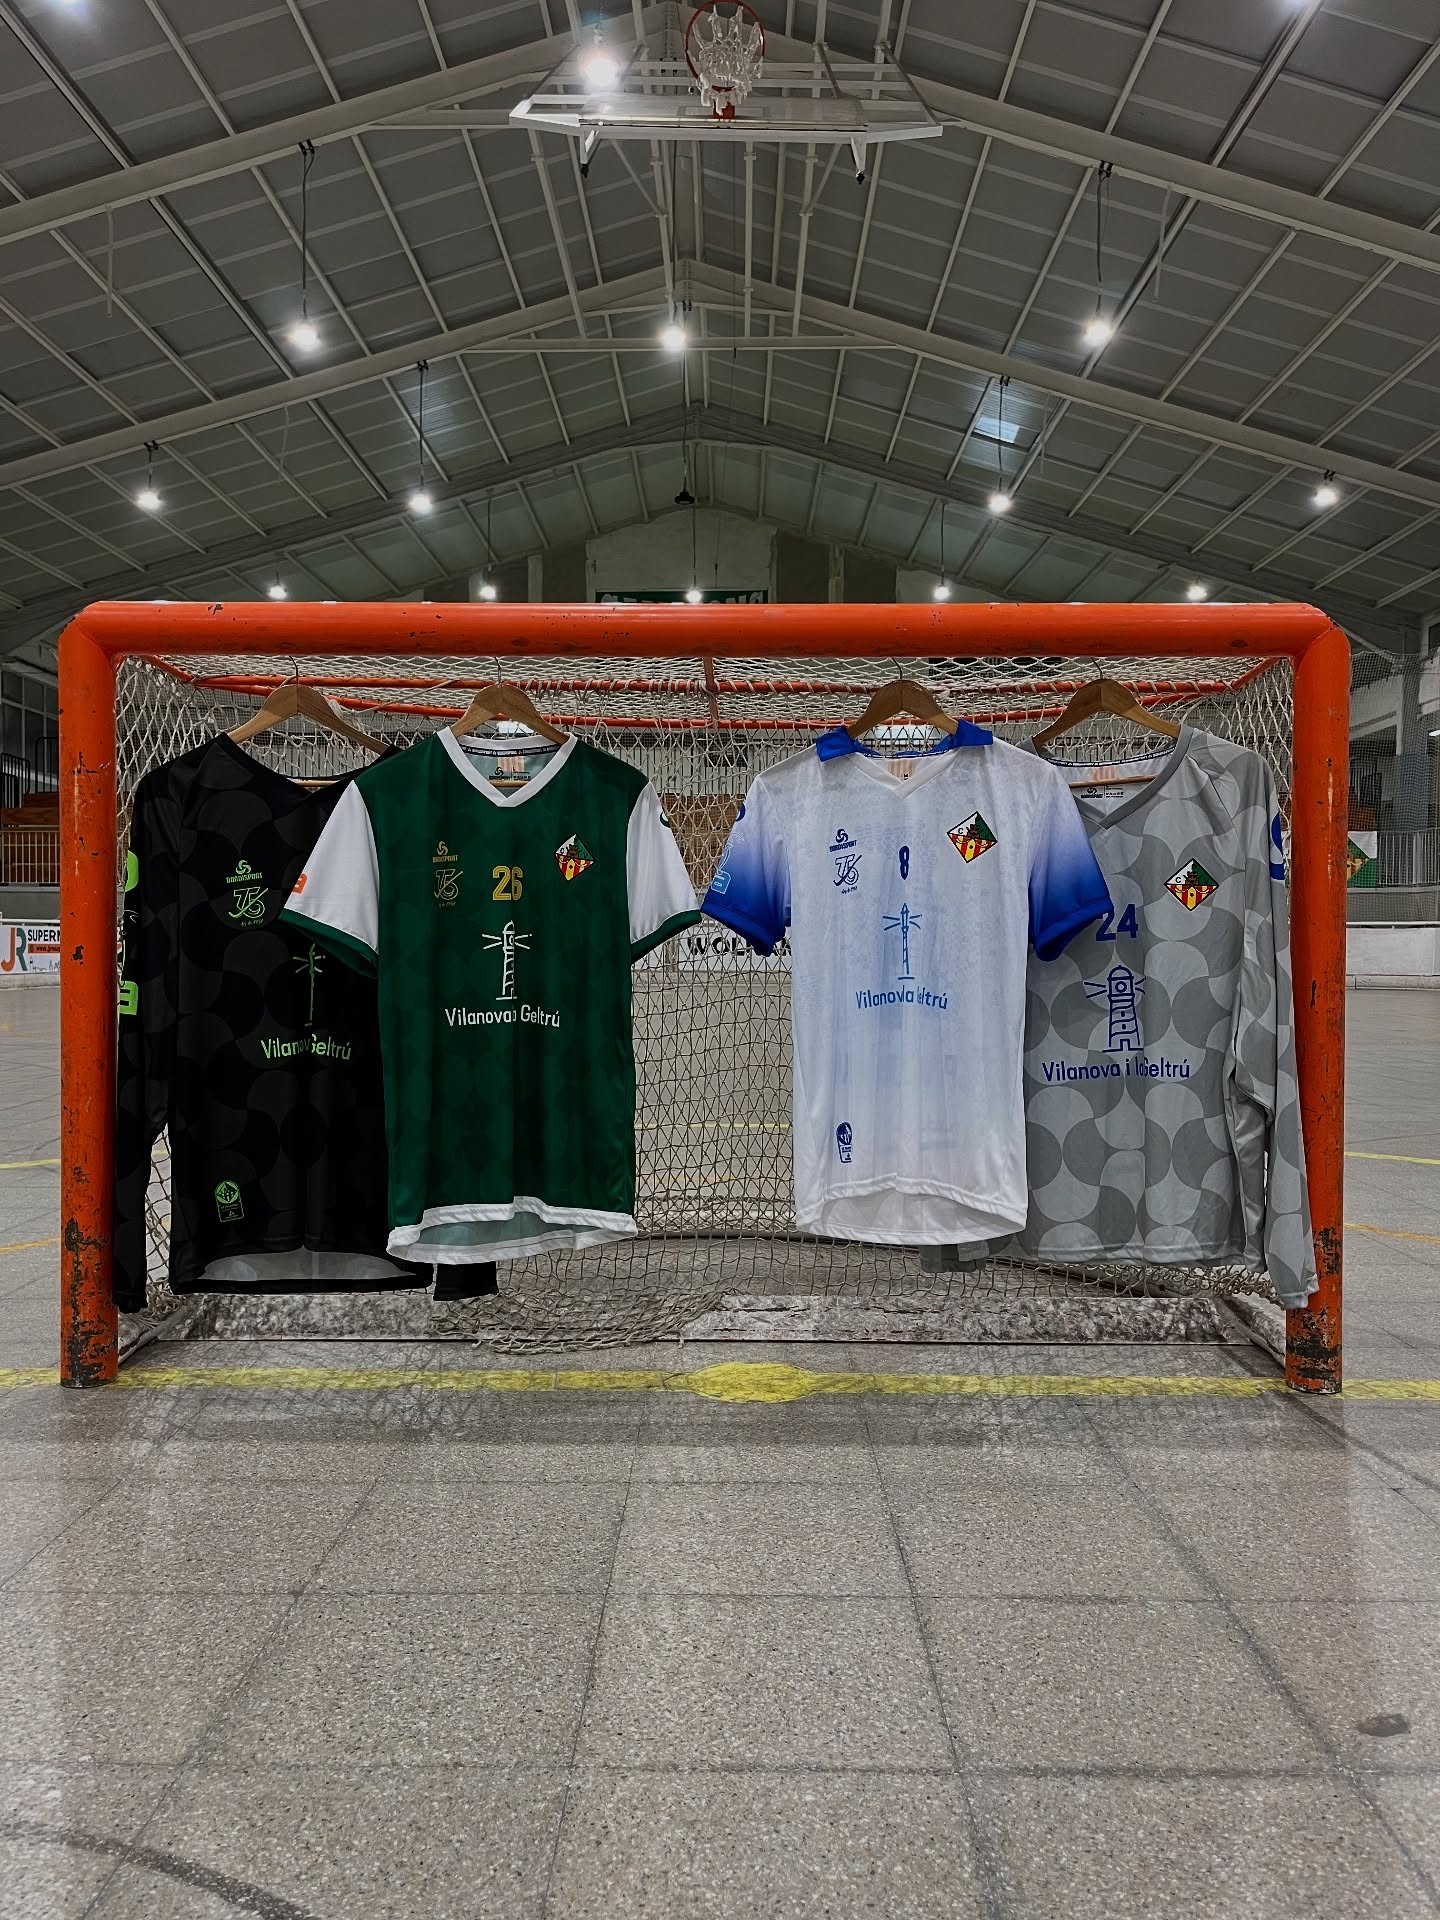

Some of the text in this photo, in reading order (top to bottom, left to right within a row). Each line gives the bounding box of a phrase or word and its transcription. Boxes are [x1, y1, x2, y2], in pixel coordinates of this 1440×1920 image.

[492, 865, 524, 901] 26
[1095, 903, 1139, 942] 24
[855, 989, 903, 1010] Vilanov
[444, 1004, 560, 1028] Vilanova Geltrú
[260, 1037, 311, 1059] Vilanov
[1041, 1061, 1121, 1083] Vilanova
[1125, 1058, 1131, 1076] i
